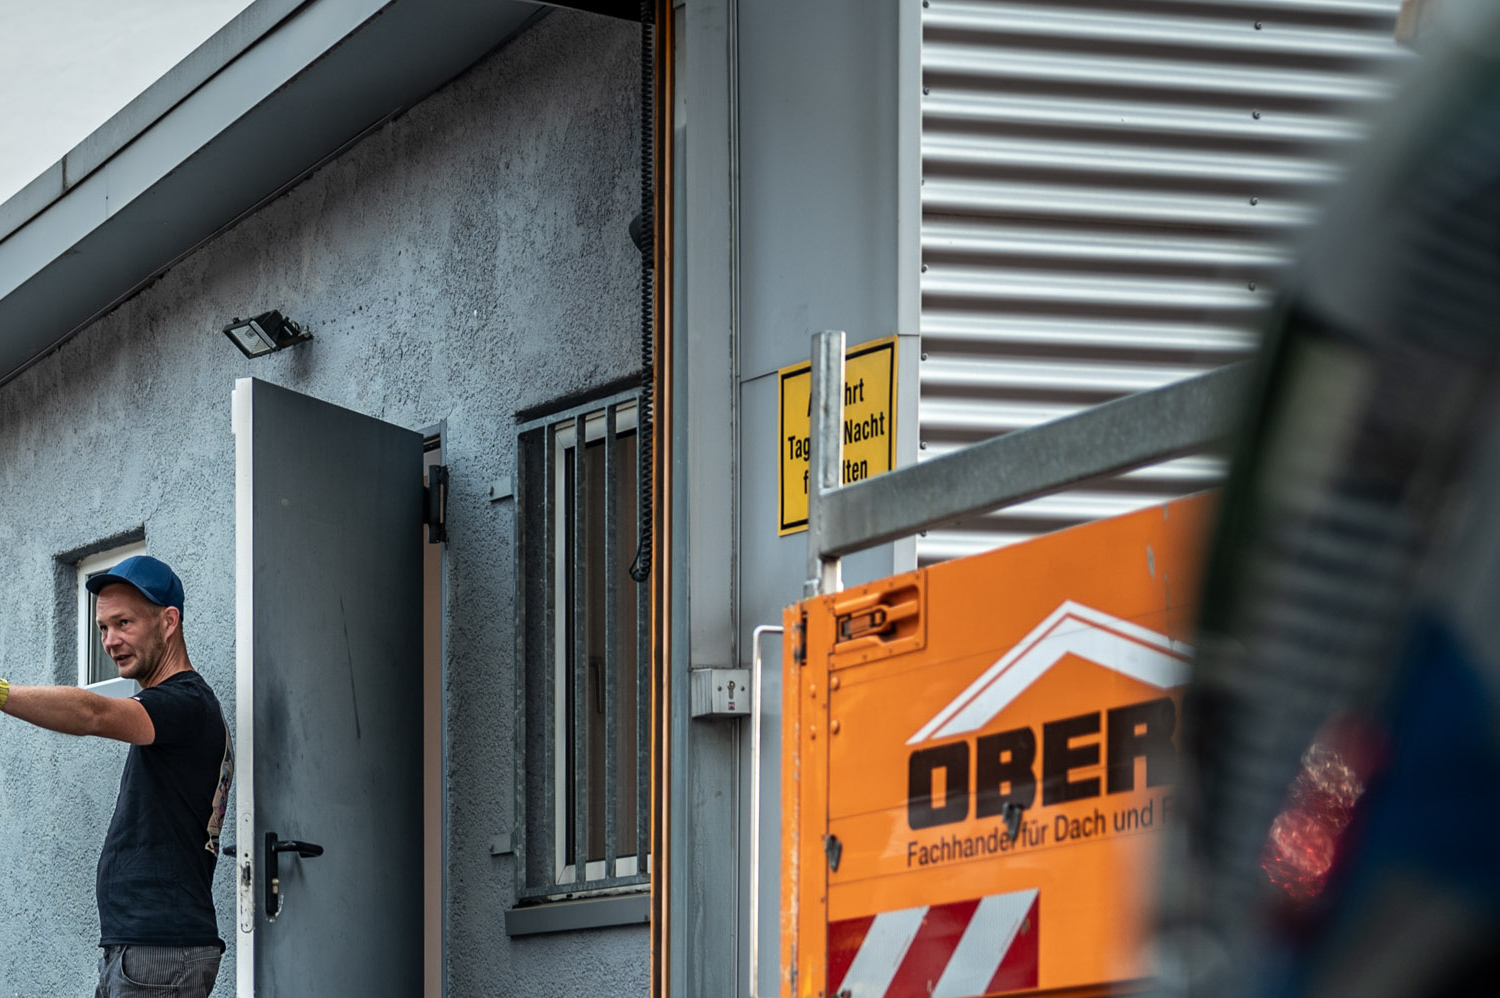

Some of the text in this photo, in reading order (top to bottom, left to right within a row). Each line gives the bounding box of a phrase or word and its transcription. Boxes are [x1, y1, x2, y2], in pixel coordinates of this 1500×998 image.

[844, 411, 885, 445] Nacht
[907, 823, 1016, 868] Fachhande
[1021, 819, 1049, 848] für
[1054, 808, 1106, 843] Dach
[1113, 797, 1153, 832] und
